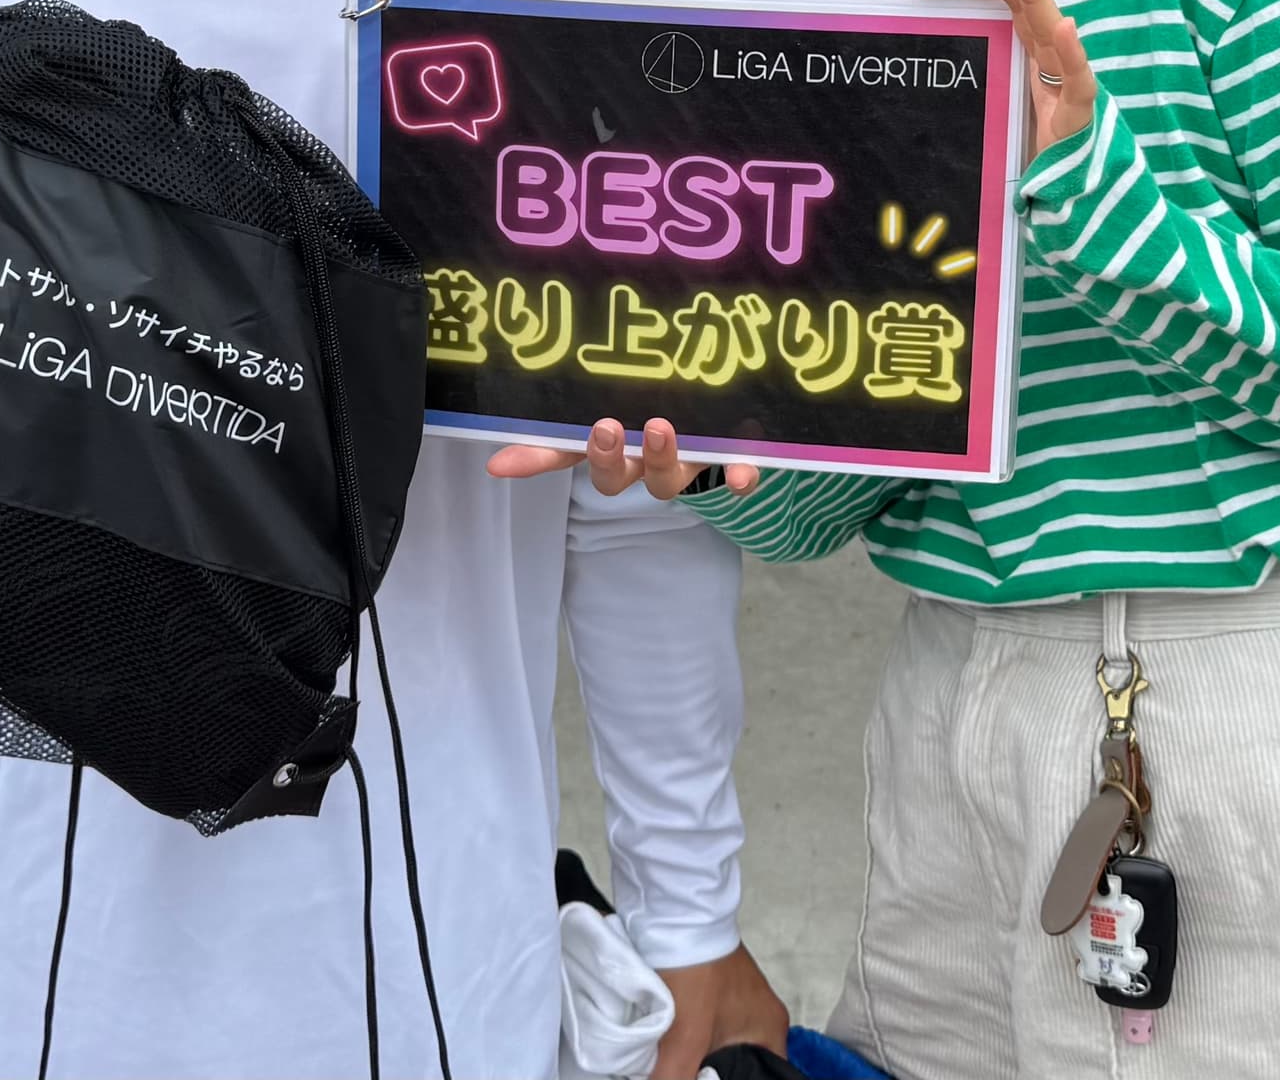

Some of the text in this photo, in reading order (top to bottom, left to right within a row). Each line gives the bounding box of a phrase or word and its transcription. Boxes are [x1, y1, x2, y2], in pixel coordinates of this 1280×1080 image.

[713, 49, 792, 82] LiGA
[496, 145, 834, 265] BEST
[423, 268, 965, 403] 盛り上がり賞
